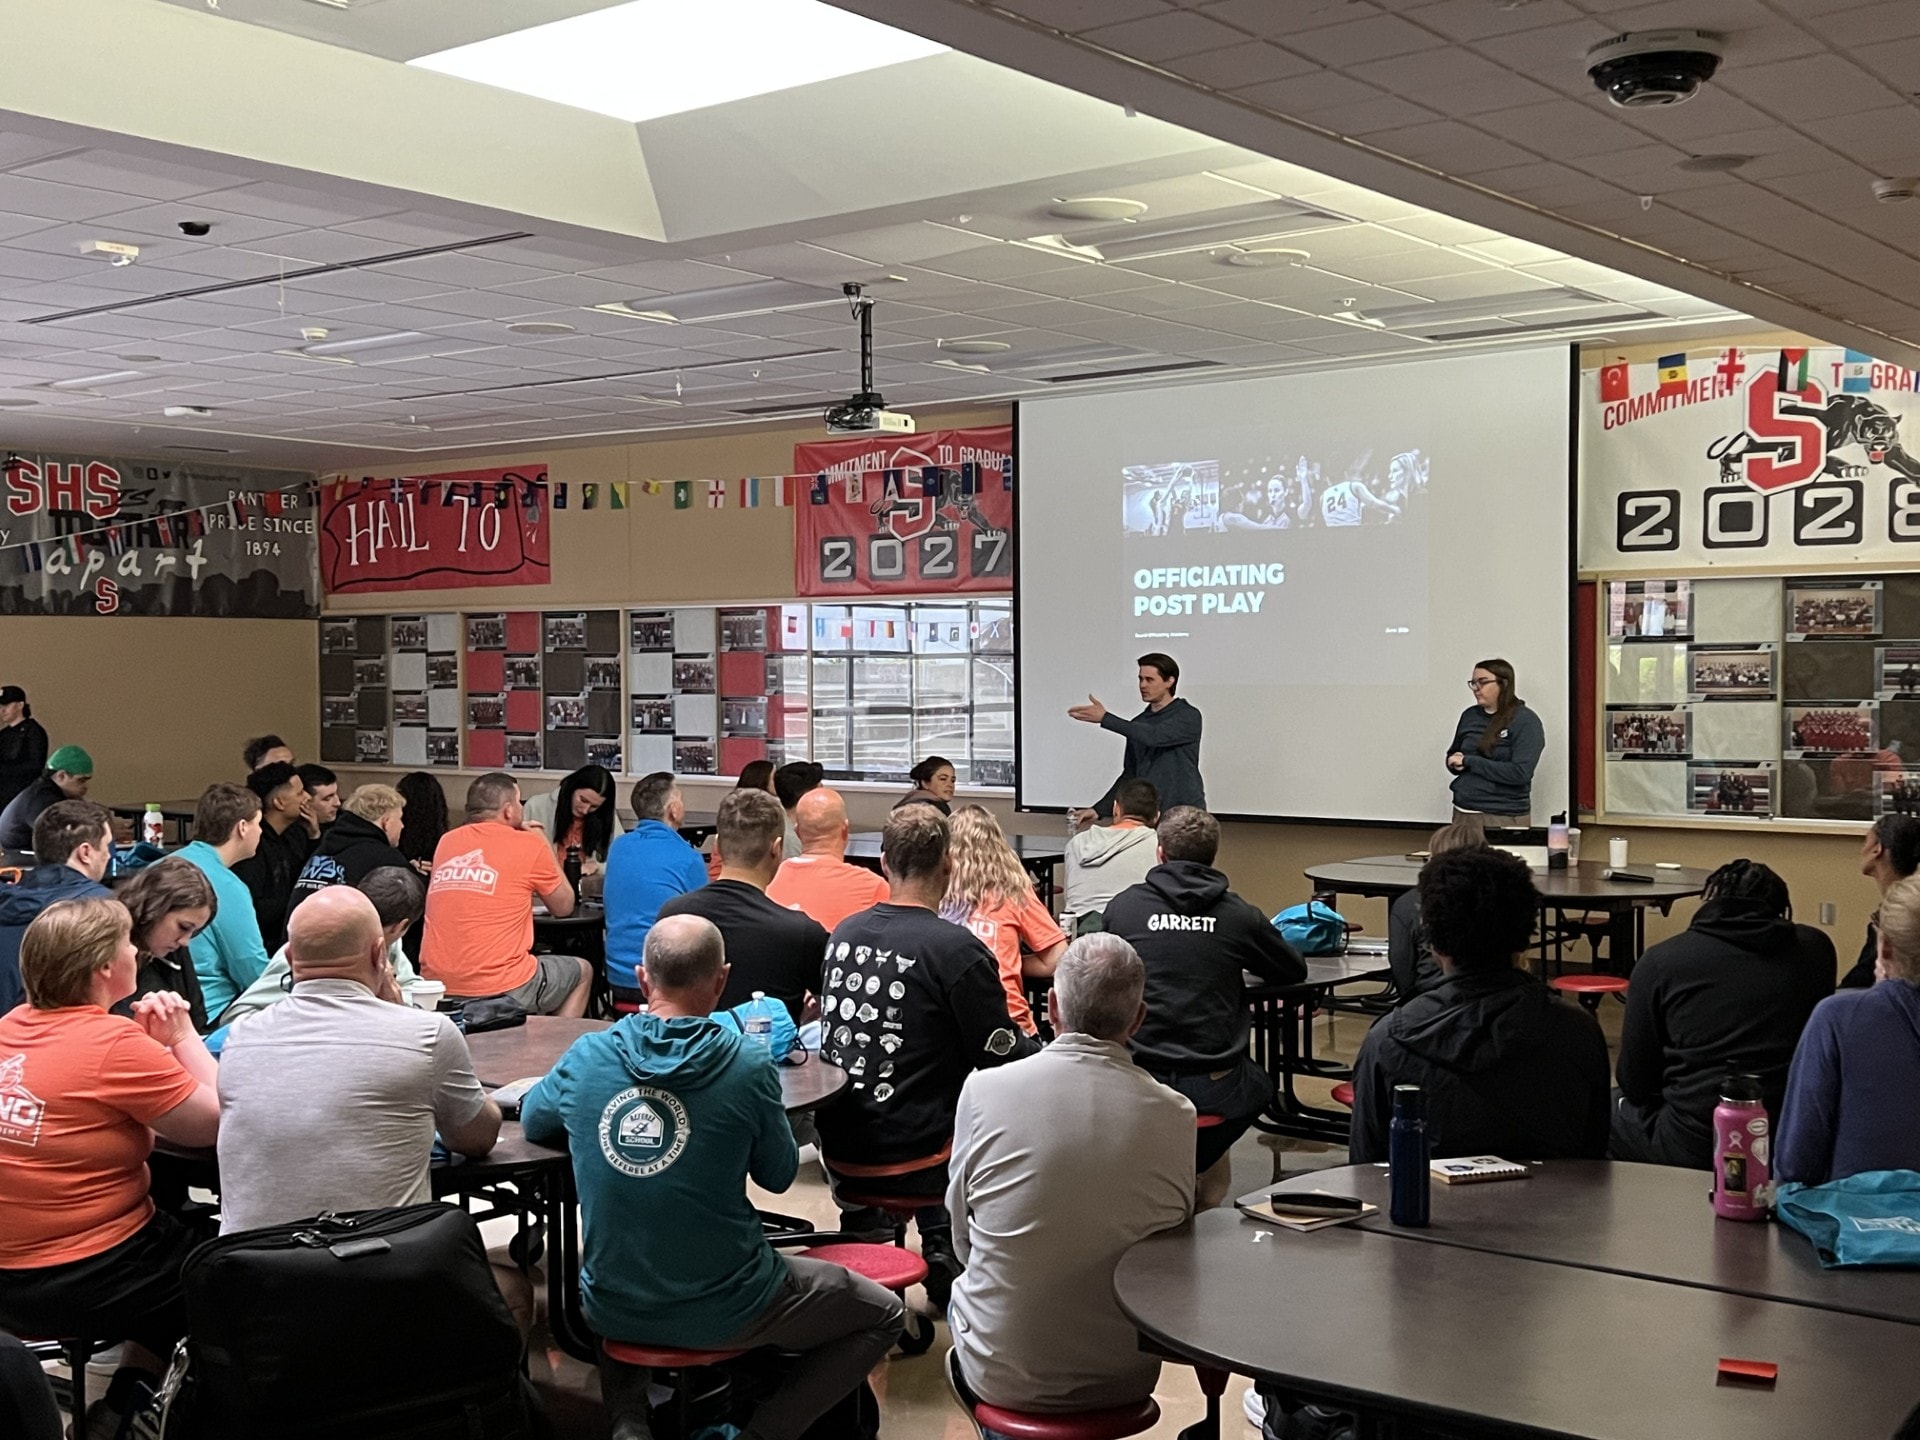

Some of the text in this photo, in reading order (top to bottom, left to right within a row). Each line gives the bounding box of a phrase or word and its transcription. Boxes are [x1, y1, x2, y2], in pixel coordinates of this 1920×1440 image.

[1604, 374, 1733, 430] COMMIMEN
[938, 445, 953, 465] TO
[6, 455, 122, 520] SHS
[228, 490, 298, 509] PANTER
[263, 517, 313, 534] SINCE
[345, 493, 501, 566] HAIL TO
[245, 541, 282, 557] 1894
[822, 533, 1008, 578] 2027
[1134, 563, 1285, 590] OFFICIATING
[1134, 591, 1265, 617] POST PLAY
[433, 867, 496, 885] SOUND
[1147, 913, 1217, 933] GARRETT
[603, 1088, 687, 1125] SAVING THE WORLD
[601, 1132, 610, 1153] ONE
[608, 1152, 646, 1175] REFEREE
[648, 1164, 660, 1174] AT
[661, 1159, 669, 1168] A
[668, 1138, 685, 1160] TIME
